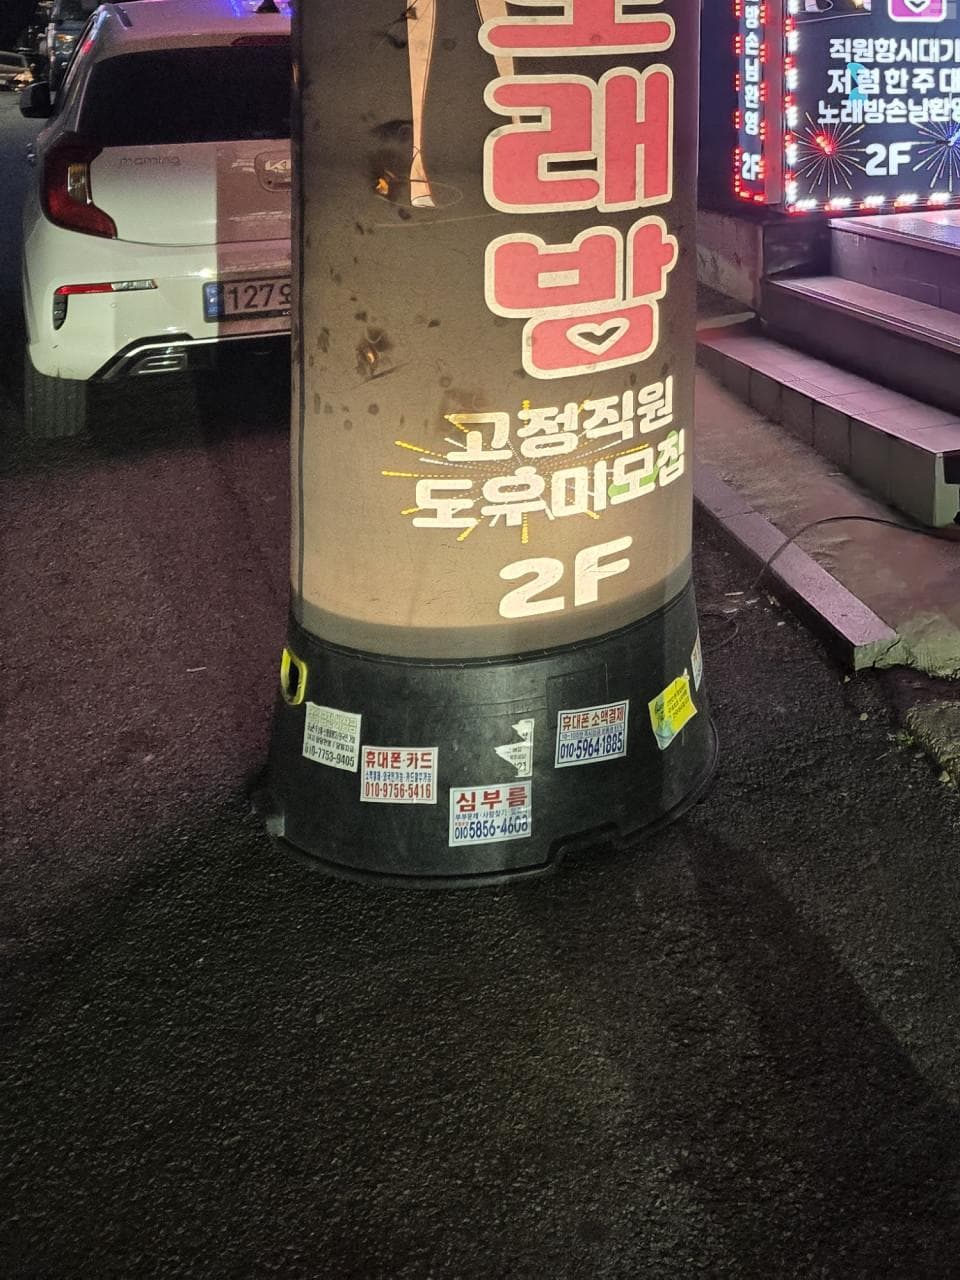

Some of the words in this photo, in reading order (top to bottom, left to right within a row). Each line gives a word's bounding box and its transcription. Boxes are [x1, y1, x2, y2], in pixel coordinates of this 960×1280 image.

[742, 151, 763, 181] 2F
[865, 142, 913, 176] 2F
[445, 375, 674, 462] 고정직원
[412, 429, 686, 529] 도우미모집
[499, 535, 633, 619] 2F
[456, 786, 528, 812] 심부름
